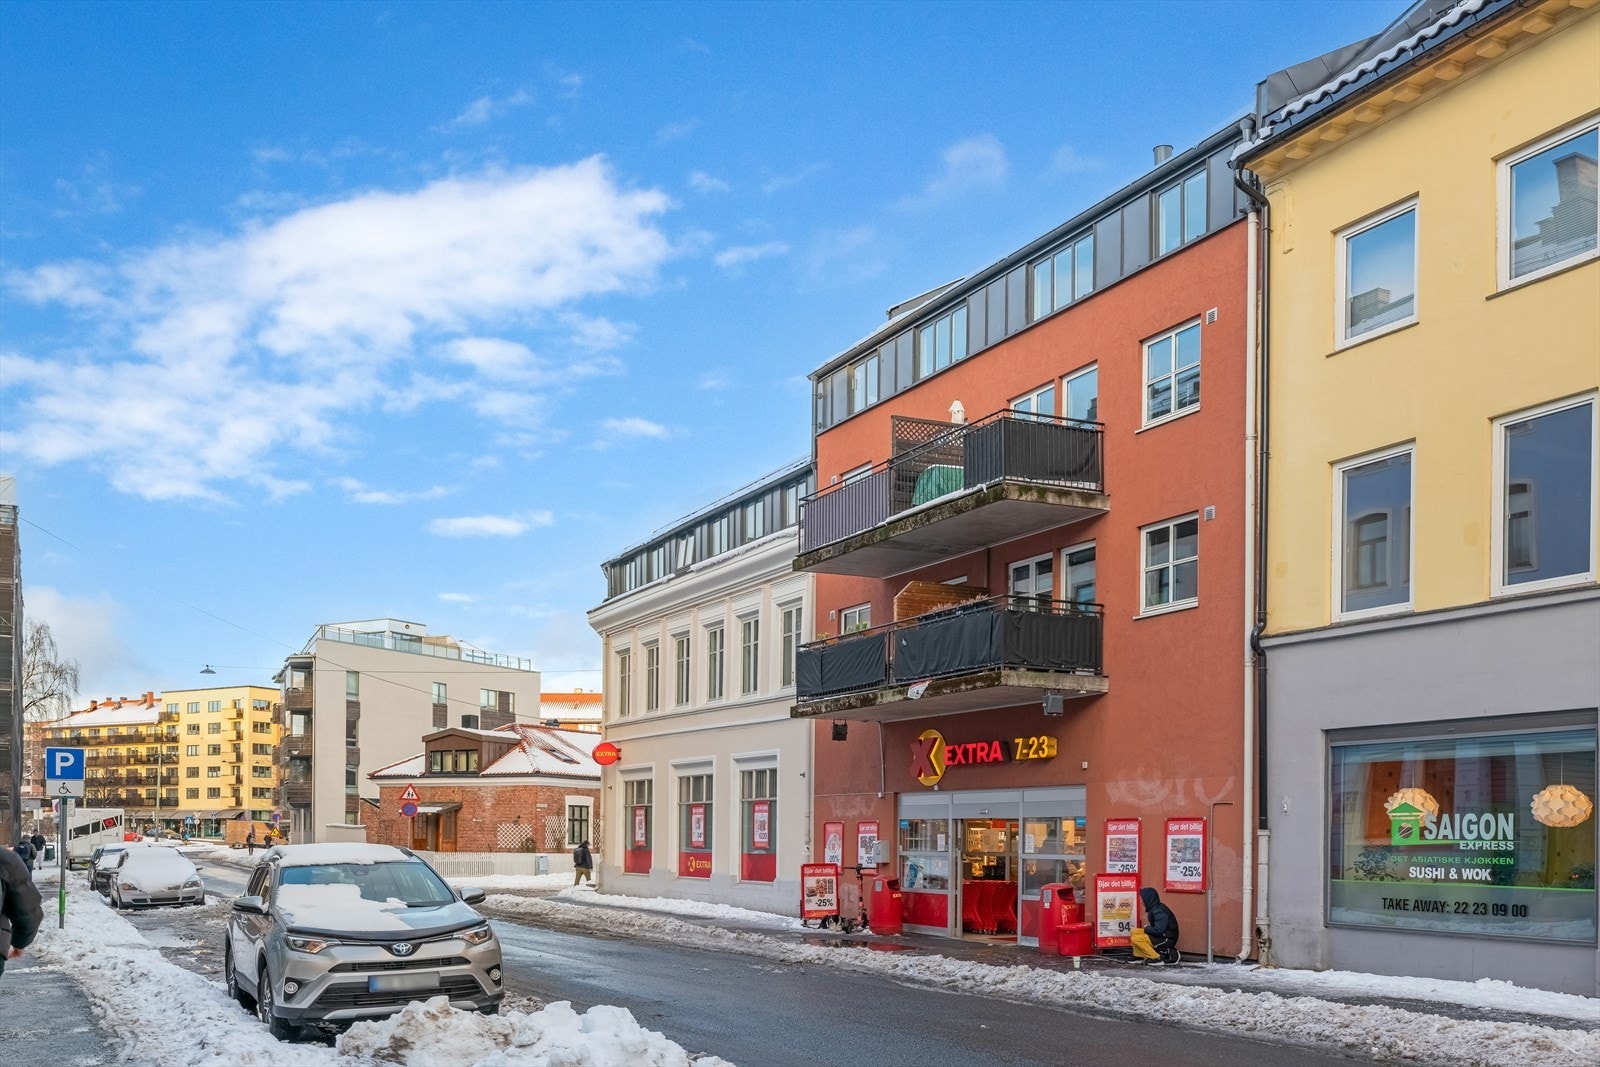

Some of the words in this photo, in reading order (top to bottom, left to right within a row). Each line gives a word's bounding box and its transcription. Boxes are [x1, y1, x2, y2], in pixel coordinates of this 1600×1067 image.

[943, 741, 1003, 766] EXTRA
[1014, 735, 1049, 760] 7-23
[55, 751, 75, 776] P
[1169, 823, 1179, 831] Gjør
[1424, 812, 1514, 841] SAIGON
[1460, 841, 1515, 850] EXPRESS
[696, 860, 712, 869] EXTRA
[1411, 856, 1461, 864] ASIATISKE
[1464, 857, 1515, 865] KJØKKEN
[1118, 864, 1137, 873] -25%
[1180, 866, 1202, 877] -25%
[1409, 866, 1445, 879] SUSHI
[1449, 868, 1458, 880] &
[1462, 868, 1492, 881] WOK
[1098, 881, 1110, 889] Gjør
[1121, 880, 1136, 889] billig!
[815, 898, 834, 907] -25%
[1382, 897, 1409, 911] TAKE
[1412, 899, 1450, 914] AWAY:
[1454, 902, 1469, 915] 22
[1473, 902, 1488, 916] 23
[1492, 903, 1507, 917] 09
[1511, 904, 1529, 917] 00
[1118, 921, 1131, 932] 94
